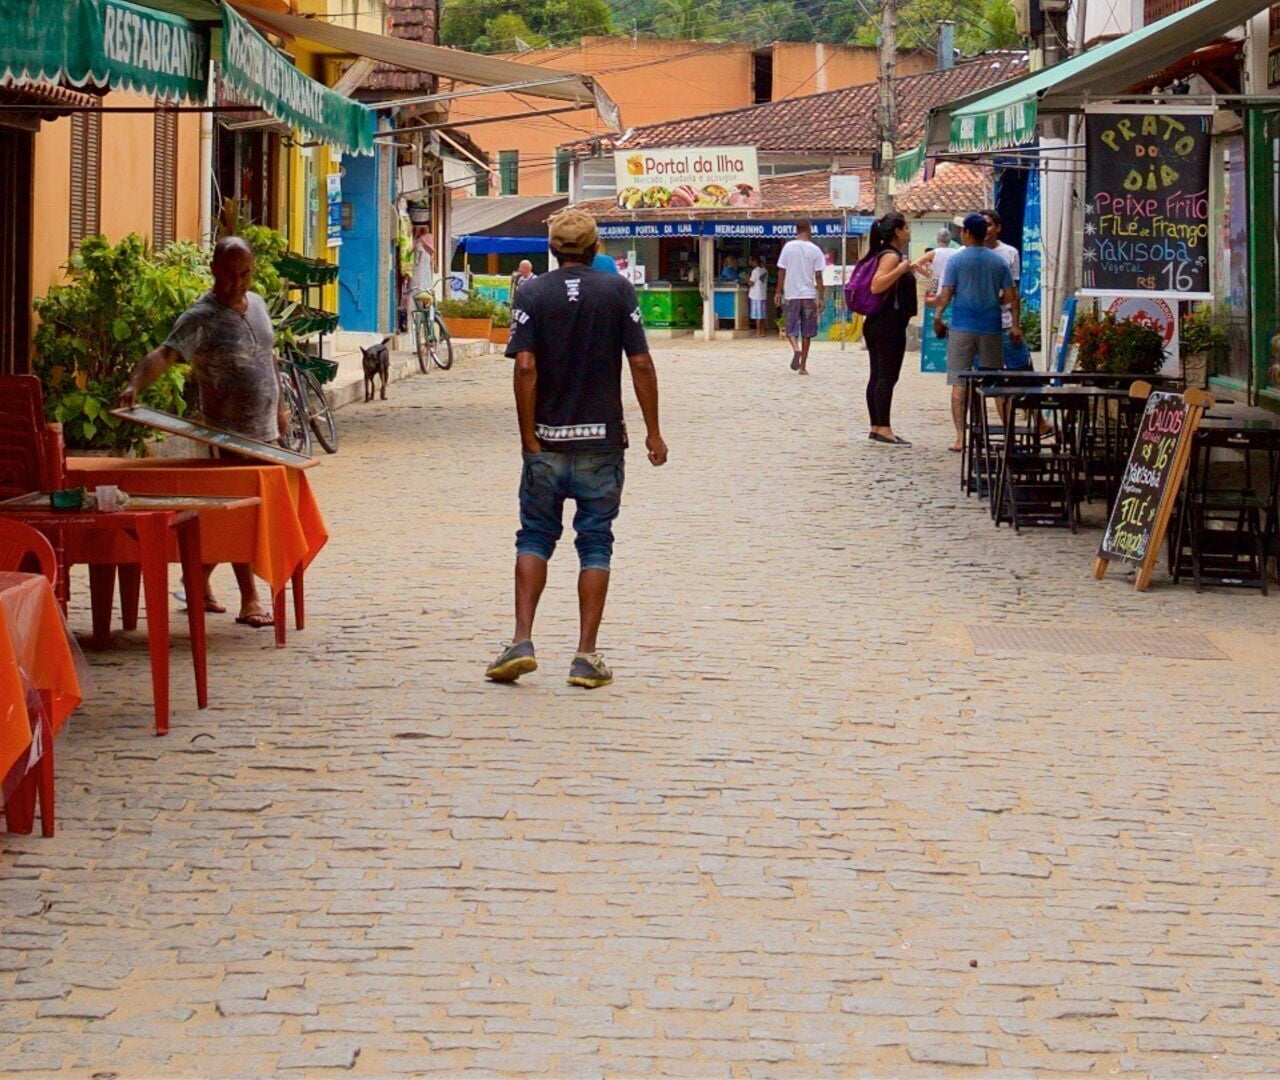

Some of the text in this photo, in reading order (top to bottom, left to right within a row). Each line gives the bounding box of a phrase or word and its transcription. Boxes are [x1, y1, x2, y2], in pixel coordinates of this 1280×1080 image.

[103, 6, 207, 80] RESTAURANTE
[1100, 114, 1196, 157] PRATO
[645, 154, 745, 175] Portal da Ilha
[1134, 144, 1159, 158] DO
[1094, 191, 1159, 218] Peixe
[635, 224, 659, 235] PORTAL
[663, 224, 674, 234] DA
[677, 223, 693, 233] ILHA
[714, 224, 765, 235] MERCADINHO
[772, 224, 799, 235] PORTA
[1139, 227, 1151, 237] de
[1151, 216, 1208, 248] Frango
[1136, 275, 1156, 290] R$
[1148, 404, 1184, 434] CALDOS
[1121, 495, 1152, 527] FILÉ
